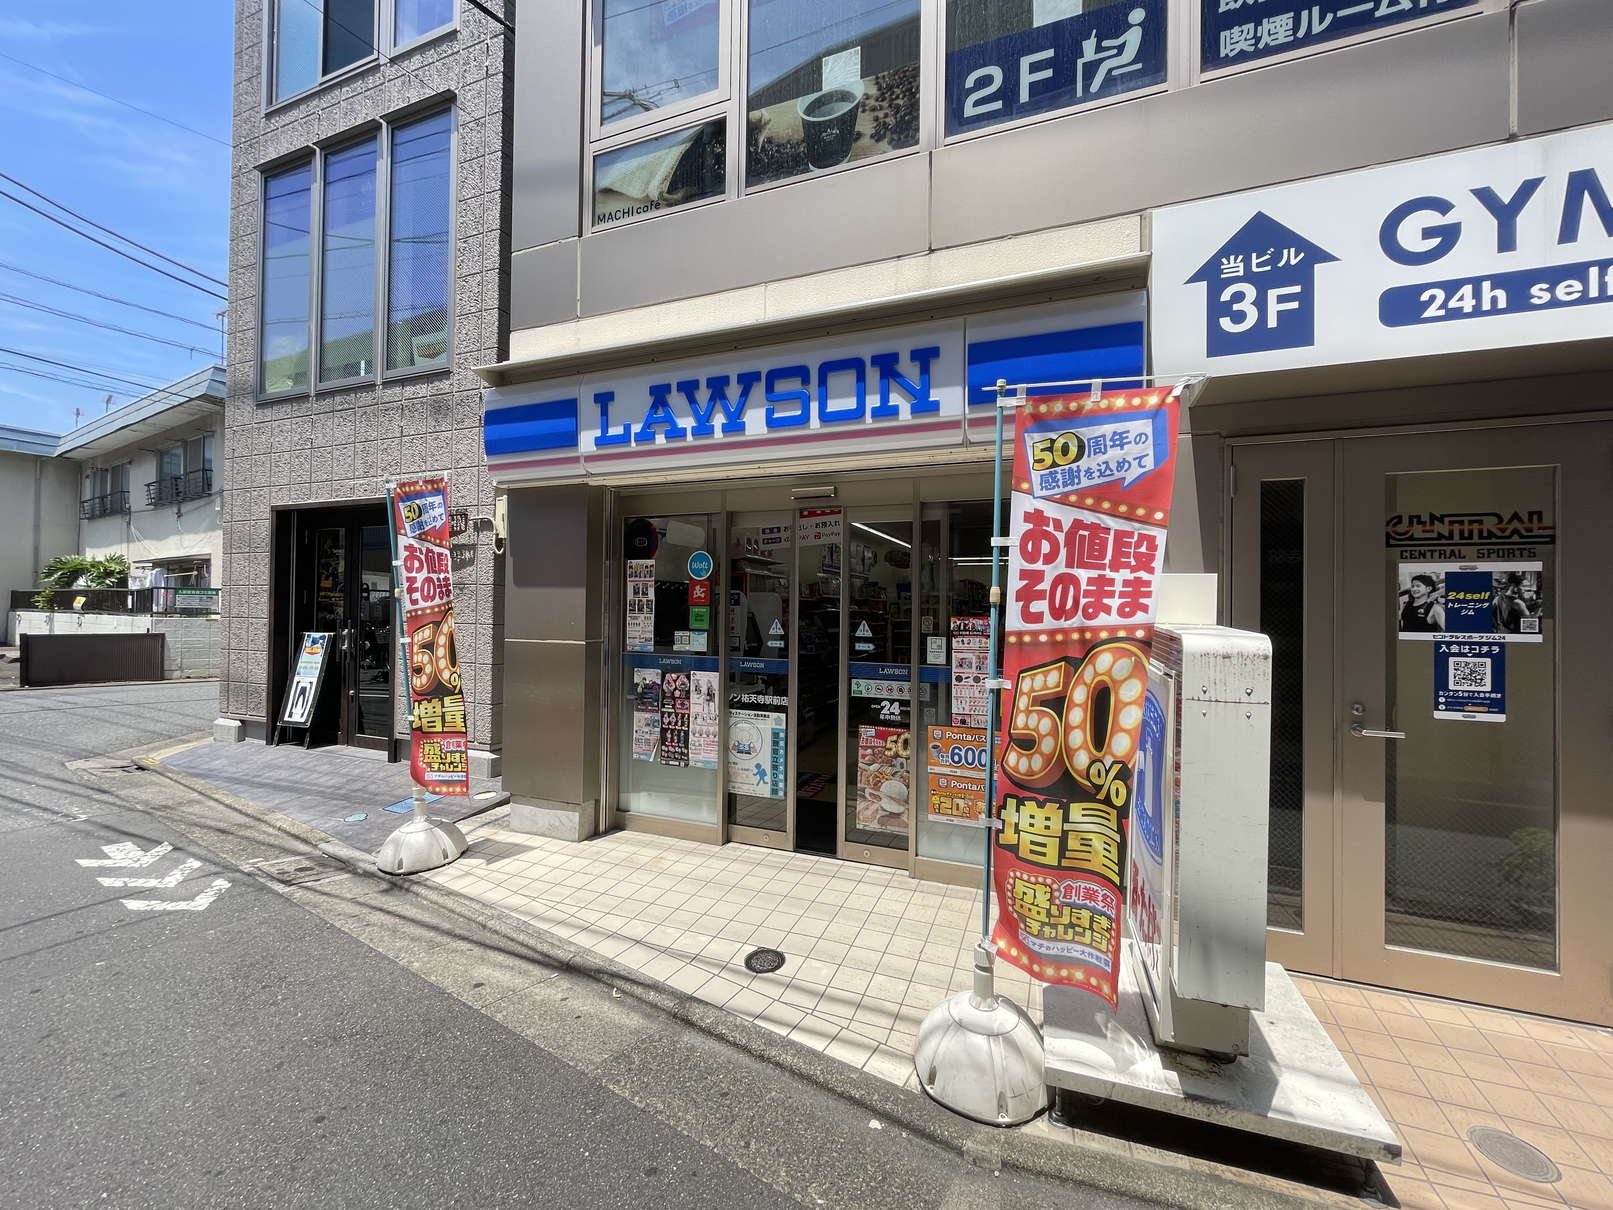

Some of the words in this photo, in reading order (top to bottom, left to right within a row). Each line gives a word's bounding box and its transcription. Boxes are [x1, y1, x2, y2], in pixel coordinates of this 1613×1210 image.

[597, 206, 634, 225] MACHI
[1220, 246, 1305, 279] 当ビル
[1218, 283, 1303, 333] 3F
[1419, 279, 1508, 319] 24h
[594, 347, 941, 447] LAWSON
[1031, 429, 1149, 471] 50周年の
[1039, 453, 1150, 491] 感謝を込めて
[1018, 507, 1158, 576] お値段
[1399, 549, 1466, 560] CENTRAL
[1476, 547, 1537, 559] SPORTS
[691, 560, 709, 570] Wolt
[1015, 567, 1153, 625] そのまま
[1446, 591, 1490, 600] 24self
[1447, 601, 1490, 609] トレーニング
[659, 657, 682, 666] LAWSON
[739, 661, 765, 669] LAWSON
[1439, 644, 1501, 654] 入会はコチラ
[879, 667, 908, 676] LAWSON
[880, 700, 901, 715] 24
[1002, 641, 1149, 808] 50%
[998, 798, 1121, 886] 増量
[1013, 877, 1112, 937] 盛りすぎ
[1062, 883, 1115, 915] 創業祭
[1026, 918, 1109, 952] チャレンジ
